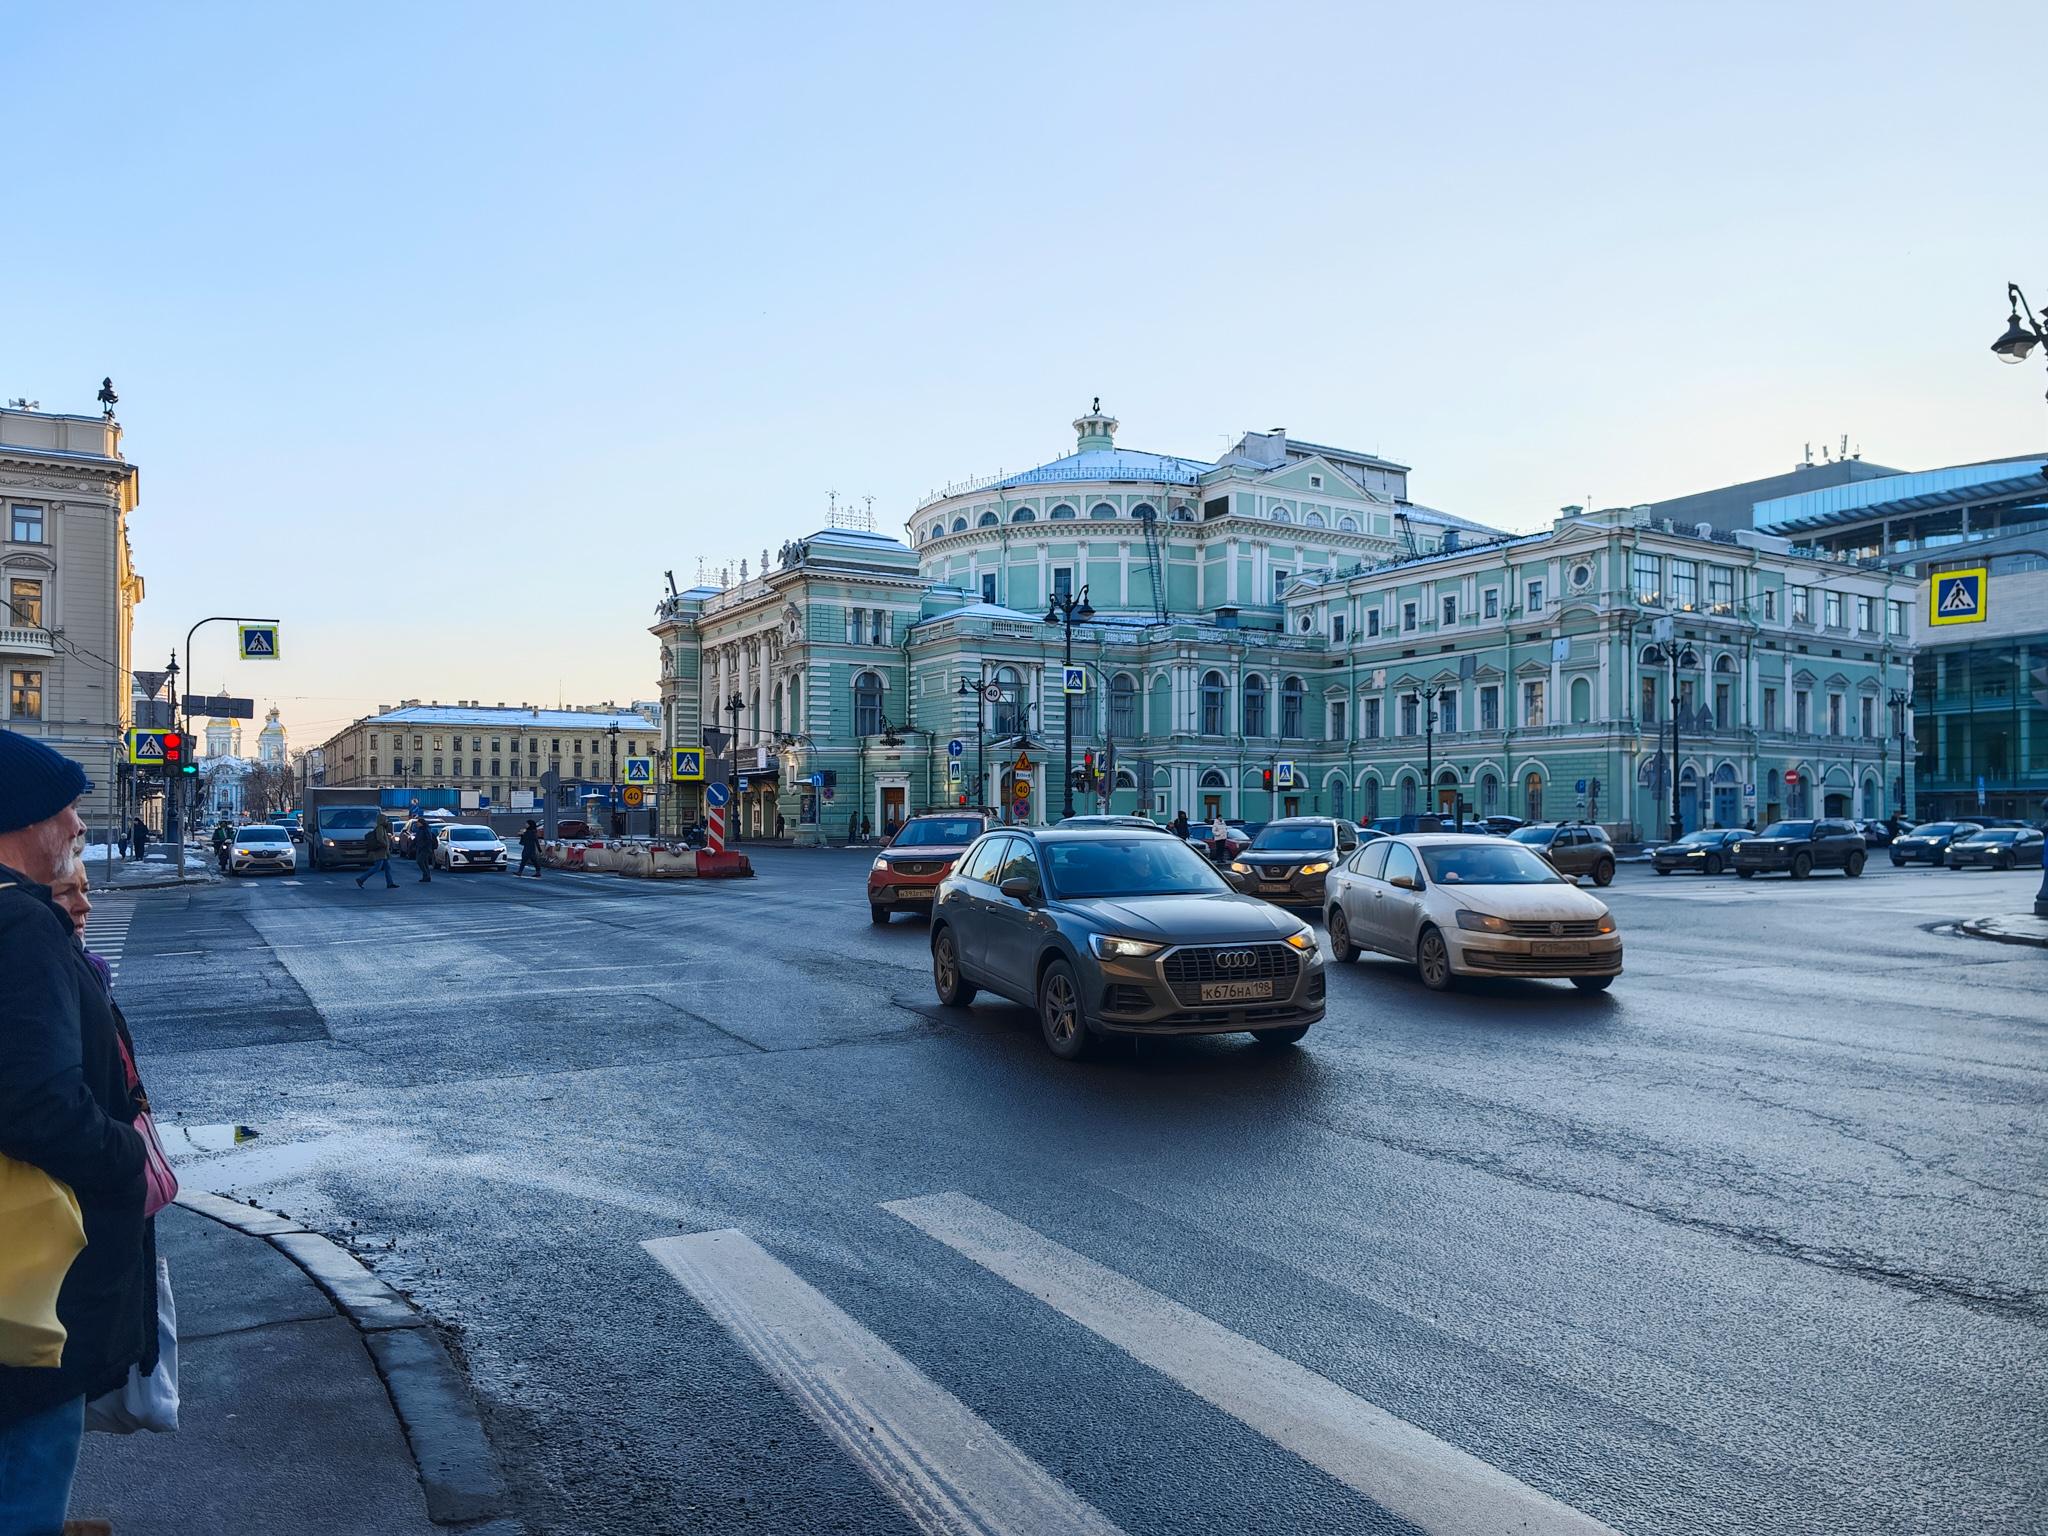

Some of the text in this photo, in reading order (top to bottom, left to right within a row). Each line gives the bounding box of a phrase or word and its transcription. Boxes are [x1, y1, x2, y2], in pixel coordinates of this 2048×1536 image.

[988, 689, 998, 697] 40
[1018, 785, 1028, 793] 40
[628, 792, 638, 800] 40
[1206, 981, 1270, 999] К676НА 198
